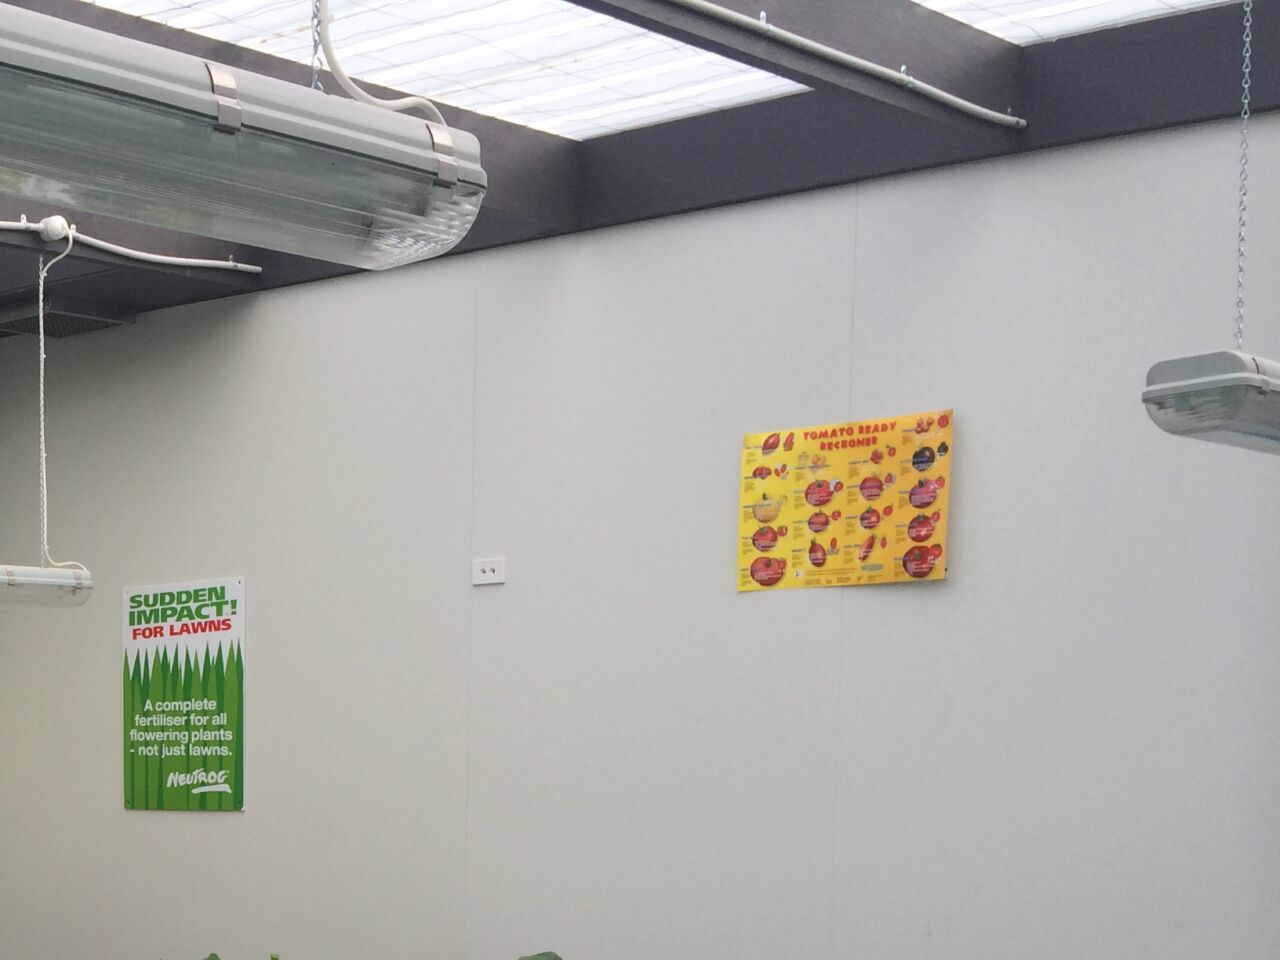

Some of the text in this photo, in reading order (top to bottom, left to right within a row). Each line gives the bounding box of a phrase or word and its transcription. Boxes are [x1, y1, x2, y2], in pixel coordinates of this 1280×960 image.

[803, 421, 896, 440] TOMATO READY
[129, 586, 226, 609] SUDDEN
[129, 599, 238, 626] IMPACT!
[132, 618, 232, 640] FOR LAWNS
[144, 698, 217, 713] A complete
[134, 712, 227, 726] fertiliser for all
[129, 728, 233, 743] flowering plants
[138, 744, 159, 756] not
[161, 744, 186, 758] just
[189, 744, 232, 756] lawns.
[166, 768, 228, 788] NEUTROG
